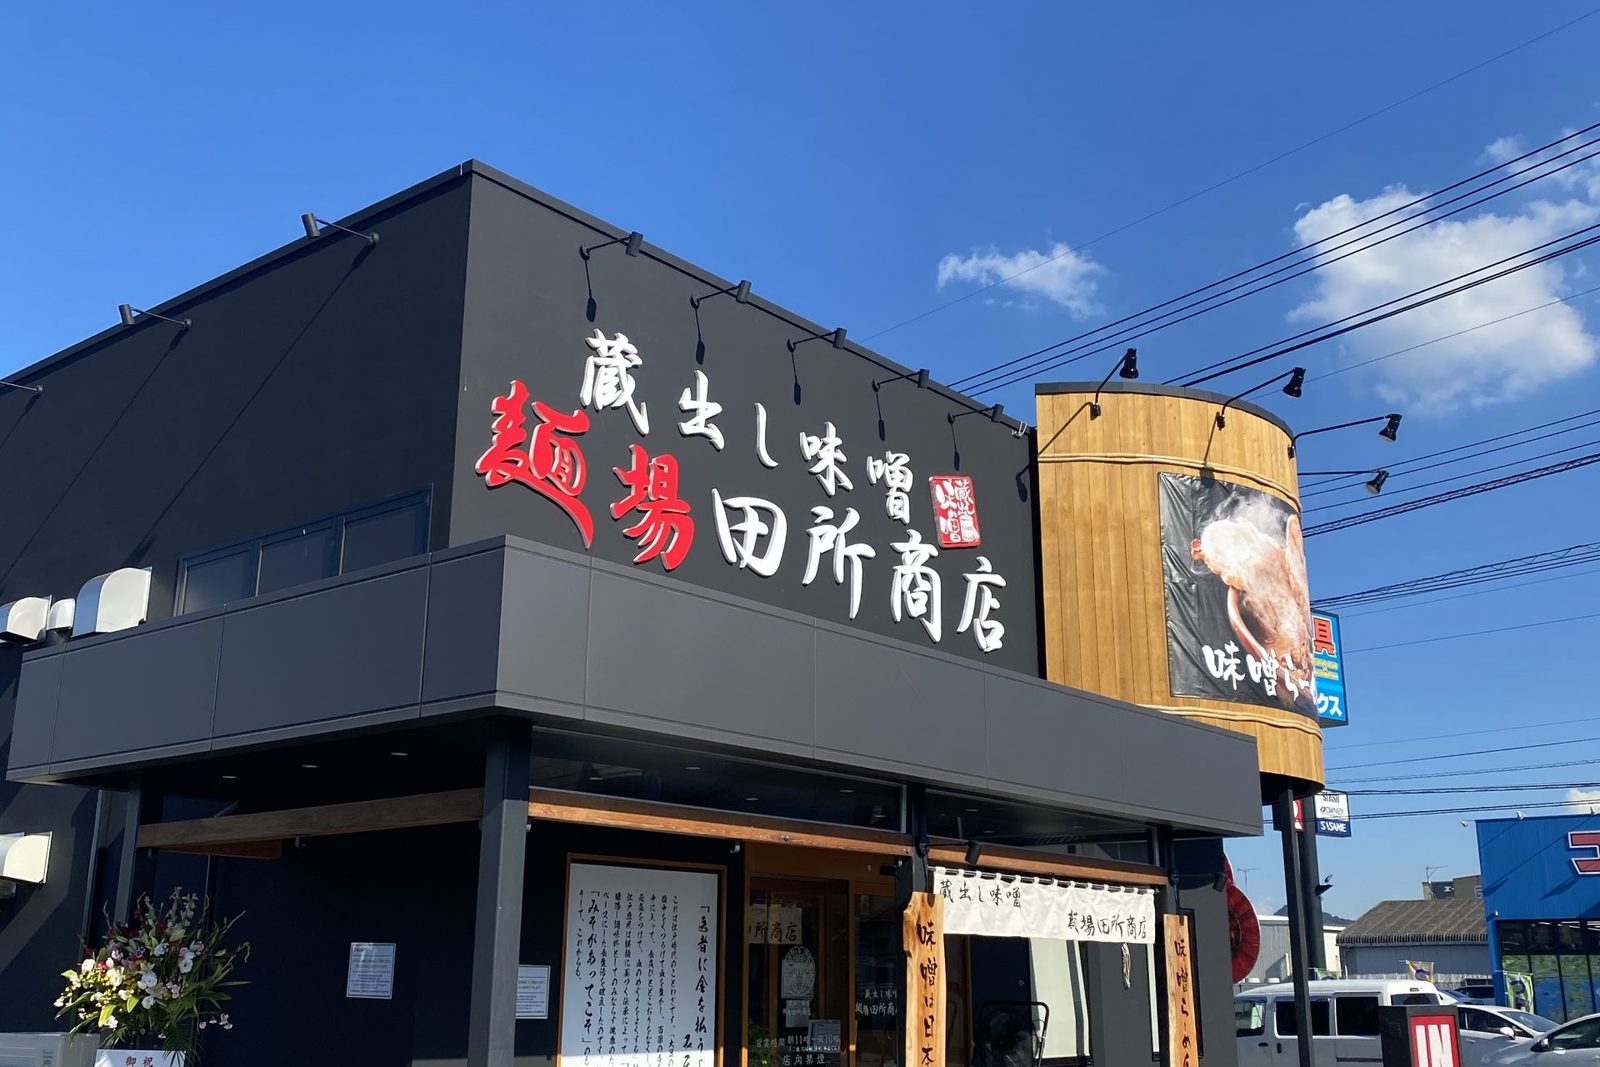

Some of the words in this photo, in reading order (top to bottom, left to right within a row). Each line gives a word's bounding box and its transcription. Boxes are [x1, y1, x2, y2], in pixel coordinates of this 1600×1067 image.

[580, 328, 914, 524] 蔵出し味噌
[1313, 617, 1336, 656] 具
[1202, 641, 1317, 704] 味噌らー
[1317, 693, 1342, 716] クス
[939, 880, 1021, 908] 蔵出し味噌
[749, 921, 798, 942] 所商店
